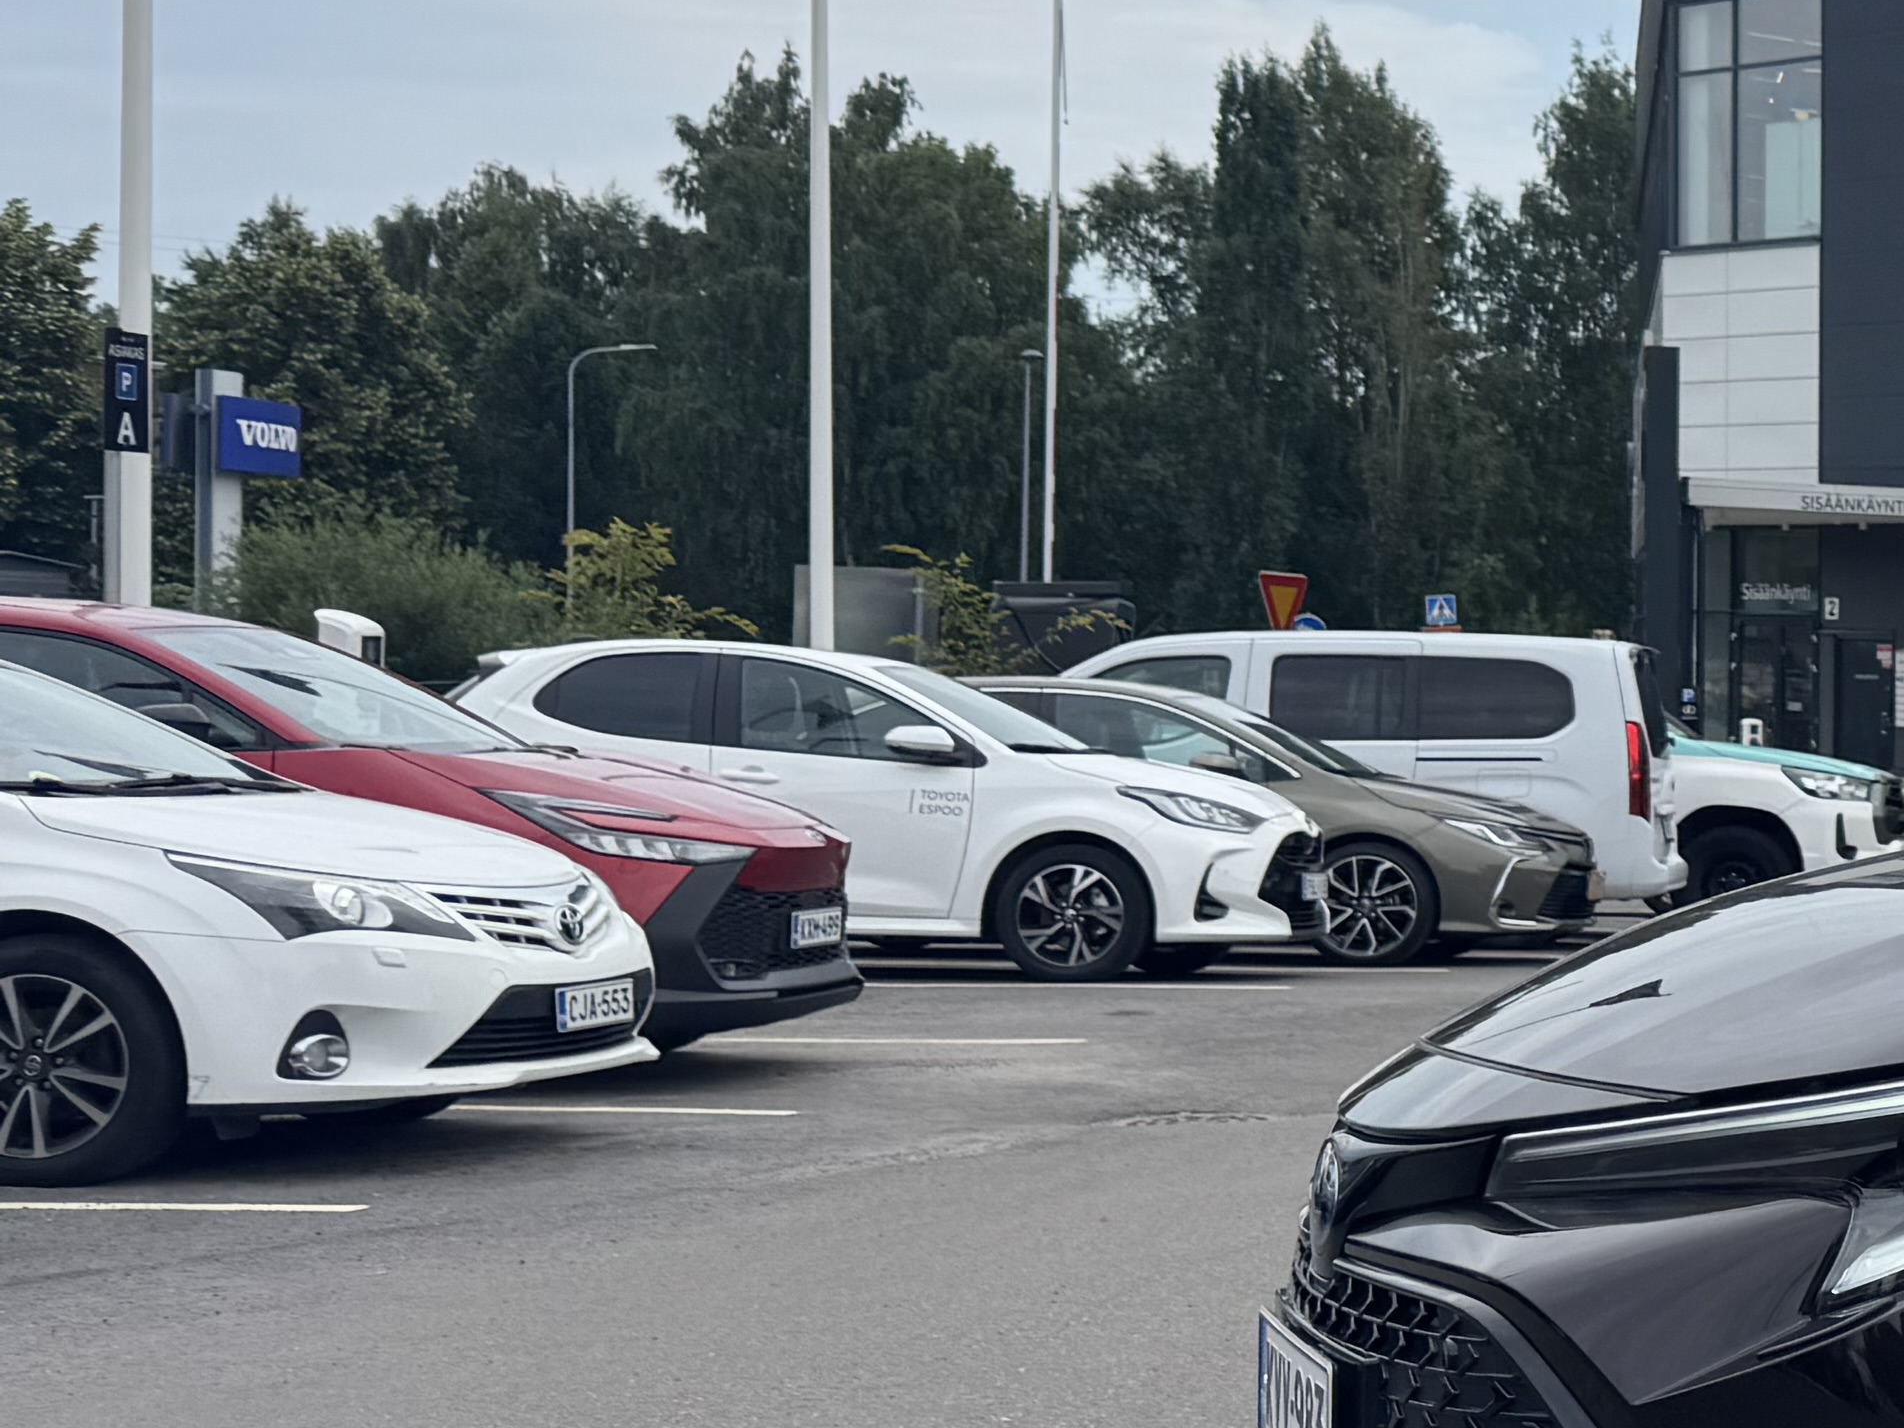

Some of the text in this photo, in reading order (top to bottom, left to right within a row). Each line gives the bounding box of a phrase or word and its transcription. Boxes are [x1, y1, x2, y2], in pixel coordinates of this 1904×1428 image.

[121, 371, 132, 392] P
[117, 411, 137, 446] A
[235, 418, 297, 453] VOLVO
[1828, 600, 1837, 617] 2
[921, 788, 970, 803] TOYOTA
[919, 802, 963, 817] ESPOO
[568, 987, 630, 1022] CJA-553
